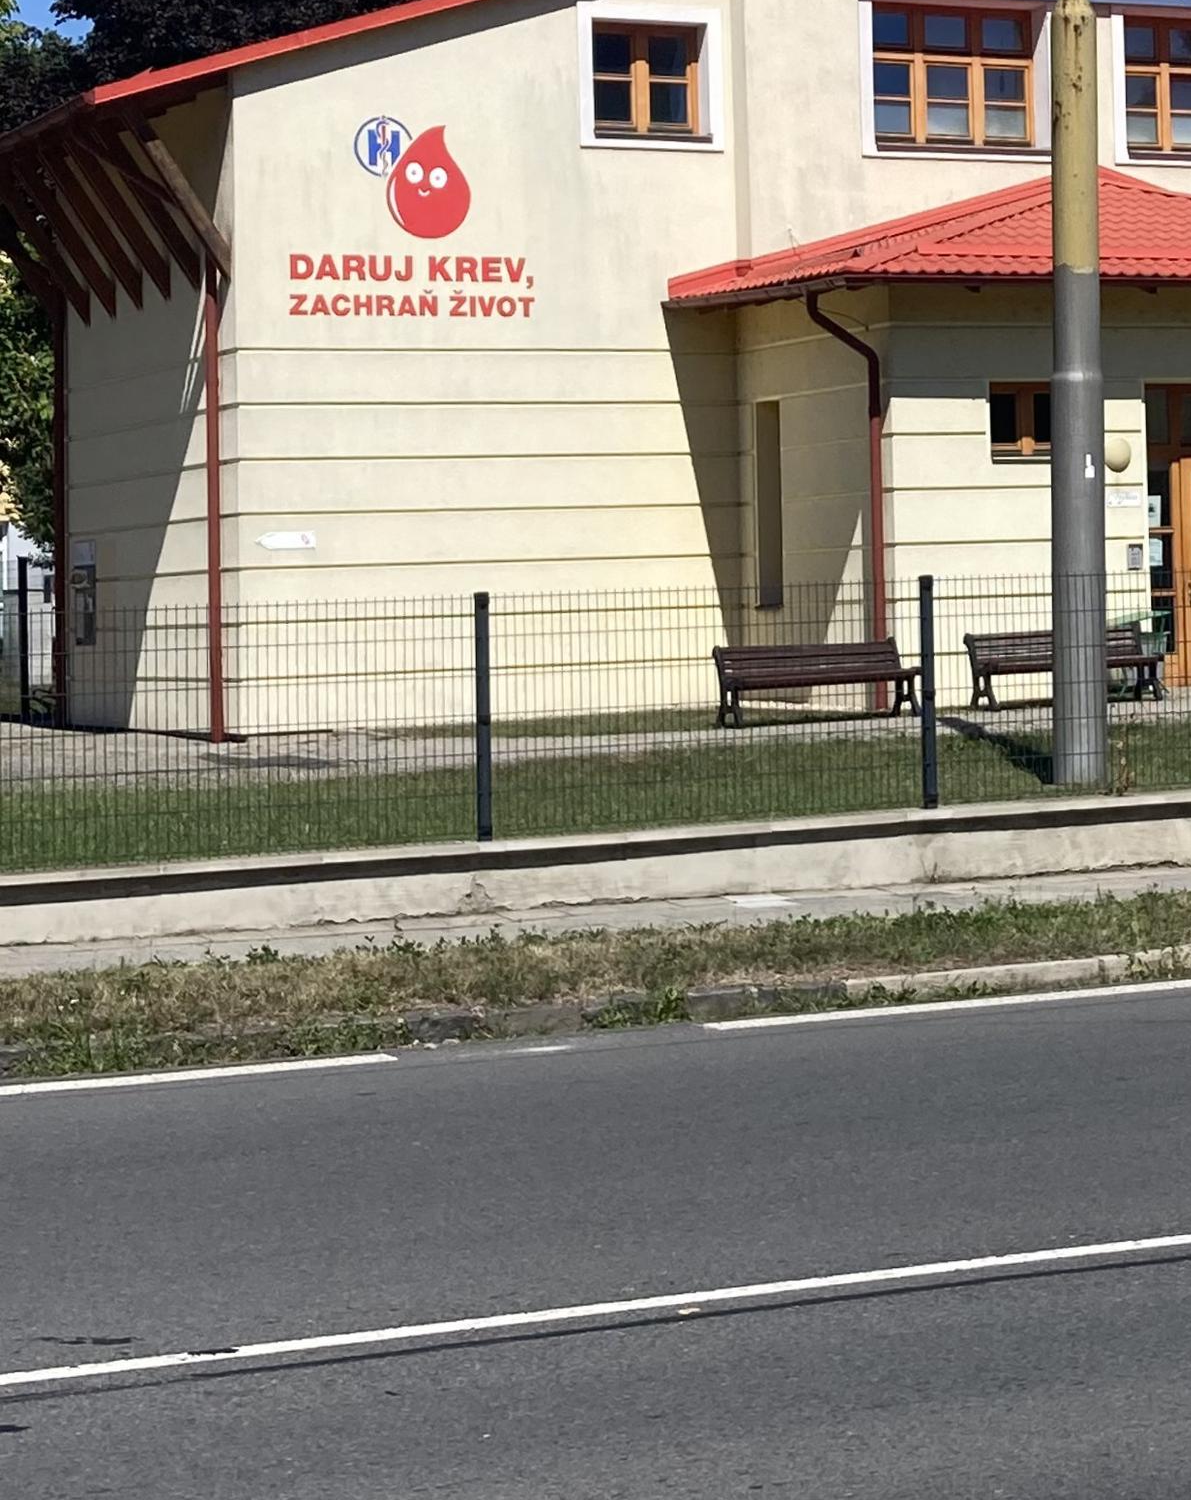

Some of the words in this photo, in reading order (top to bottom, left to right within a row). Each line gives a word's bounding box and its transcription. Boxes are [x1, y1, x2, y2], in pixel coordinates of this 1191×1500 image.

[289, 253, 413, 282] DARUJ
[428, 255, 534, 289] KREV,
[288, 289, 439, 317] ZACHRAŇ
[449, 289, 535, 318] ŽIVOT
